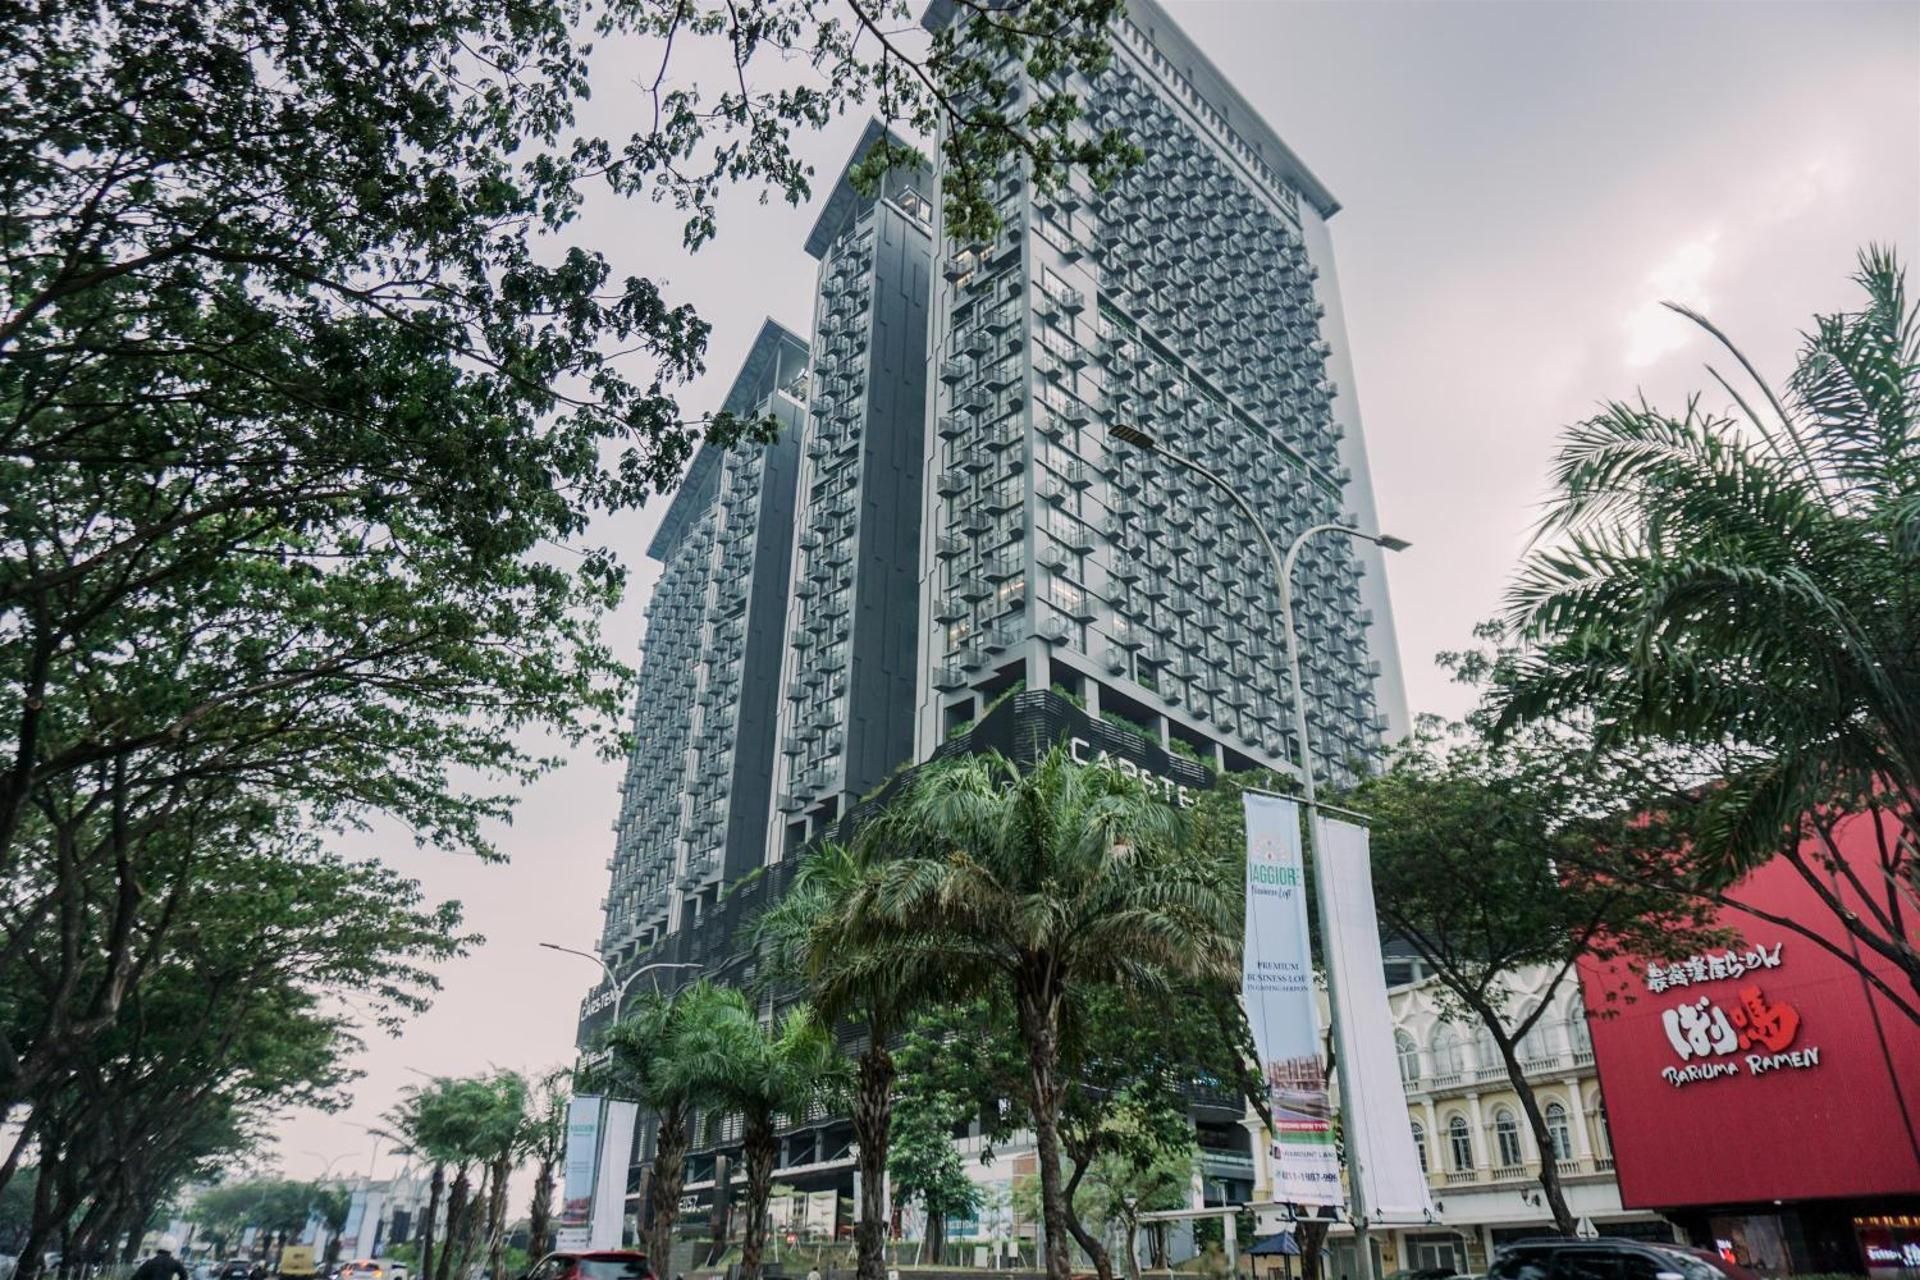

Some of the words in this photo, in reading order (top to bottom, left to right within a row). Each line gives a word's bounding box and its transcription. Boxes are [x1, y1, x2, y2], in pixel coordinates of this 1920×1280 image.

[1257, 961, 1299, 970] PREMIUM
[1662, 1062, 1739, 1087] BARIUMA
[1745, 1047, 1819, 1075] RAMEN
